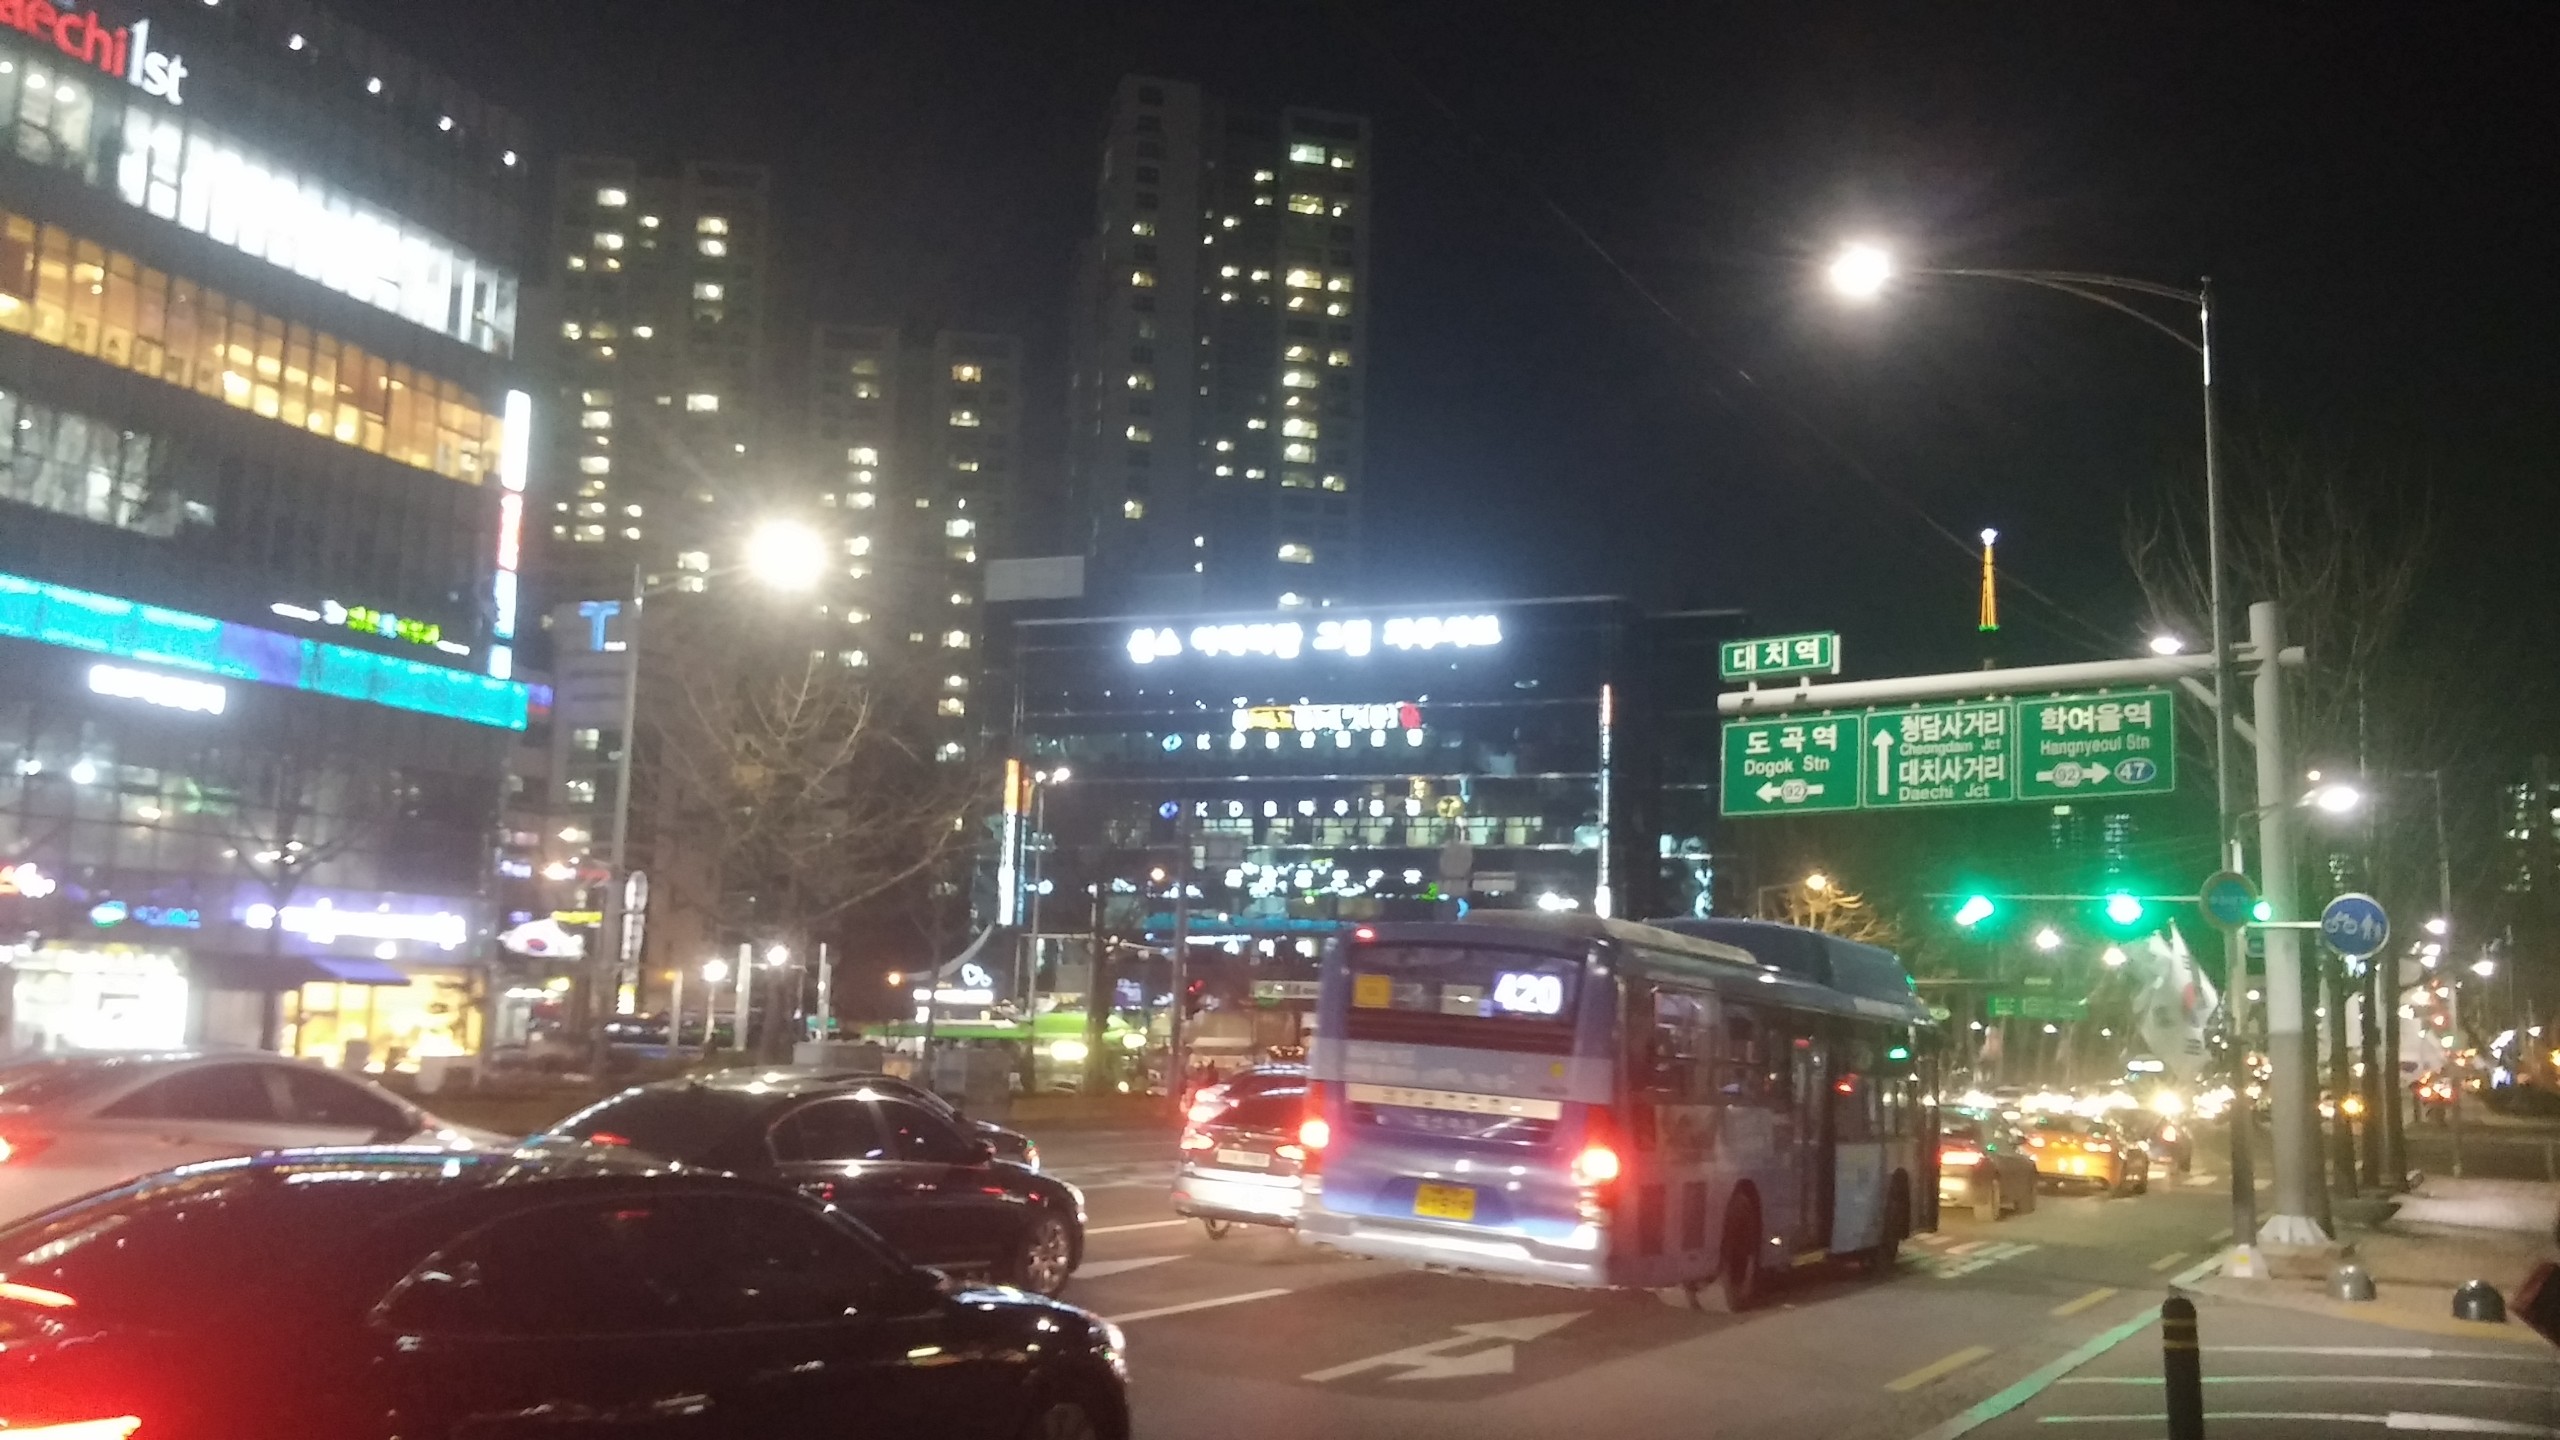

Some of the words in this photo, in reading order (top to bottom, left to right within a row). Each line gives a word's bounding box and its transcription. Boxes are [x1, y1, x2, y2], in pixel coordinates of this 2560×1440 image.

[1733, 638, 1820, 671] 대치역
[1900, 708, 2004, 742] 청담사거리
[2040, 700, 2151, 735] 학여울역
[1745, 723, 1837, 754] 도곡역
[2040, 735, 2122, 757] Hangnyeoul
[2126, 733, 2150, 750] Stn
[1744, 757, 1794, 778] Dogok
[1802, 754, 1830, 772] Stn
[1899, 753, 2005, 785] 대치사거리
[2119, 761, 2146, 780] 47
[1899, 783, 1955, 801] Daechi
[1964, 783, 1990, 798] Jct
[1494, 973, 1562, 1014] 420
